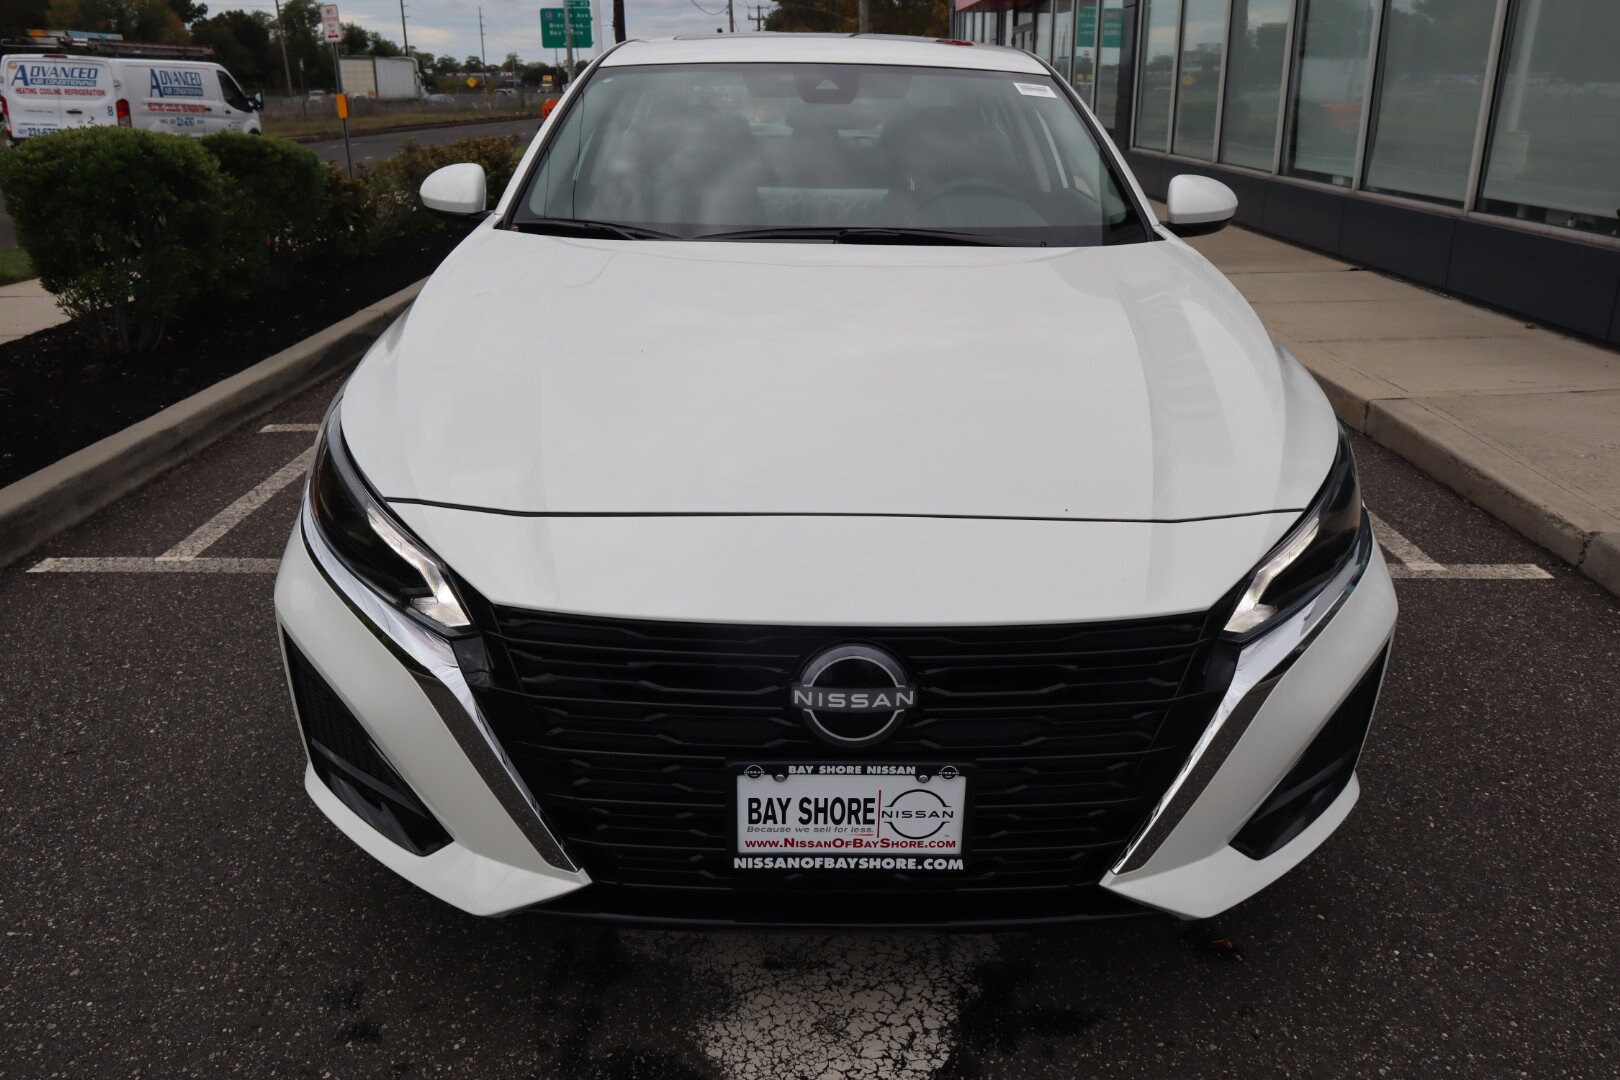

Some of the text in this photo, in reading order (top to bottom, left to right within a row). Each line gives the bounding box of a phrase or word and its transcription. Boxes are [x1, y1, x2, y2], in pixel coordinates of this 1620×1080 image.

[11, 64, 99, 86] ADVANCED
[45, 79, 96, 87] CONDITIONING
[150, 68, 202, 97] ADVANCED
[15, 87, 38, 95] HEATING
[64, 88, 107, 96] REFRIGERATION
[107, 105, 114, 116] 8
[794, 689, 914, 708] NISSAN
[788, 765, 814, 774] BAY
[818, 765, 862, 774] SHORE
[866, 766, 916, 775] NISSAN
[747, 796, 876, 825] BAY SHORE
[881, 810, 954, 819] NISSAN
[813, 825, 832, 833] sell
[834, 825, 849, 833] for
[733, 857, 964, 871] NISSANOFBAYSHORE.COM
